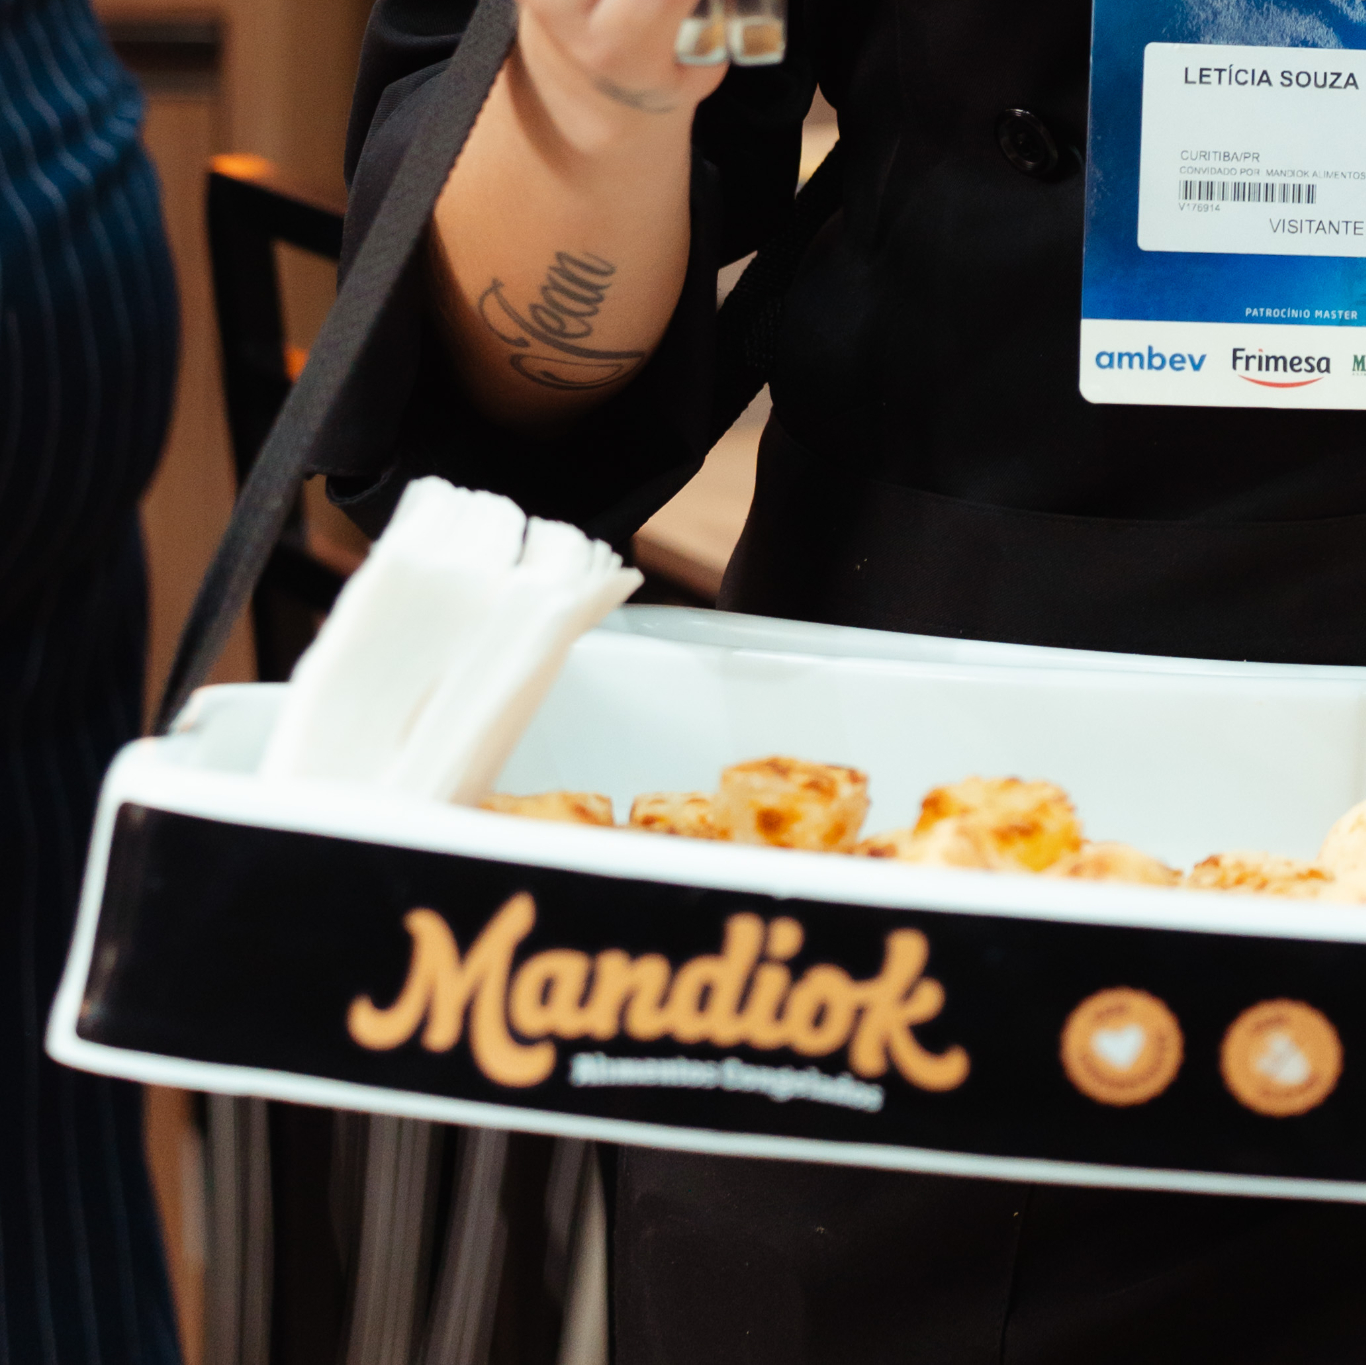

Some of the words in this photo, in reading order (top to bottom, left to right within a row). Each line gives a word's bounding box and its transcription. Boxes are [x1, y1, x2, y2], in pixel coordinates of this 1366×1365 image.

[1183, 64, 1273, 87] LETÍCIA
[1279, 69, 1360, 90] SOUZA
[1180, 149, 1261, 163] CURITIBA/PR
[1179, 166, 1238, 176] CONVIDADO
[1265, 169, 1310, 179] MANDIOK
[1312, 171, 1366, 180] ALIMENTOS
[1269, 218, 1365, 236] VISITANTE
[1245, 306, 1311, 319] PATROCÍNIO
[1315, 309, 1358, 320] MASTER
[1095, 345, 1208, 372] ambev
[1231, 347, 1332, 374] Frimesa
[347, 890, 971, 1092] Mandiok
